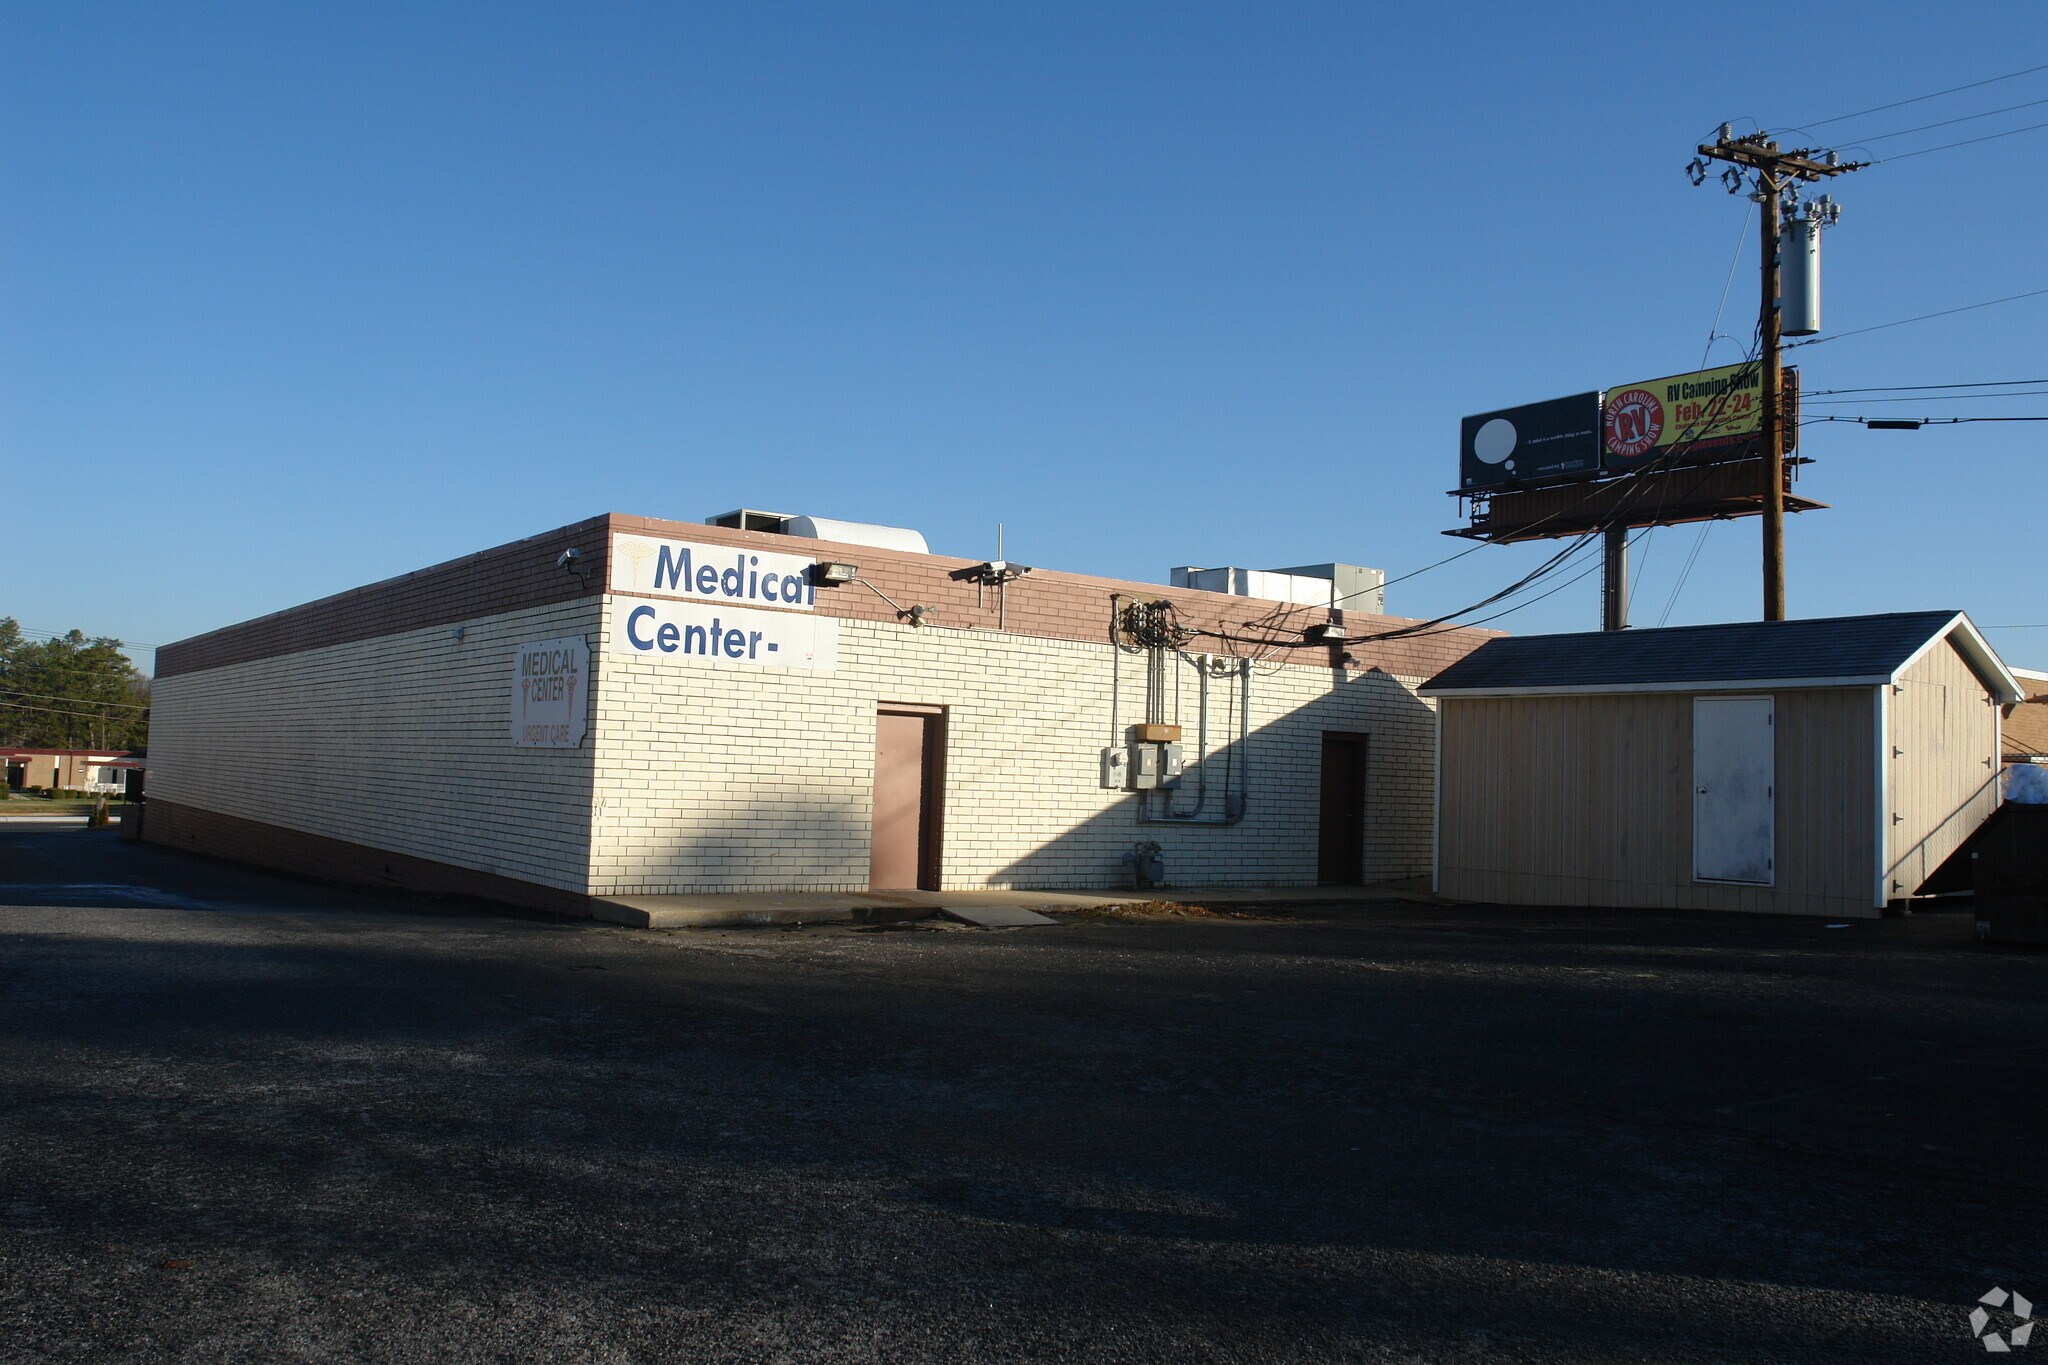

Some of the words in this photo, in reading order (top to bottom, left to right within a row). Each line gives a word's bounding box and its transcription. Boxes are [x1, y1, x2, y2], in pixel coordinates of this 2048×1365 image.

[1667, 384, 1680, 402] RV
[1682, 377, 1728, 400] Camping
[1606, 399, 1623, 427] NORTH
[1623, 392, 1659, 414] CAROLINA
[1618, 406, 1645, 442] RV
[1607, 436, 1641, 455] CAMPING
[1640, 423, 1660, 450] SHOW
[653, 545, 815, 605] Medical
[522, 648, 578, 677] MEDICAL
[531, 676, 564, 703] CENTER
[522, 724, 549, 743] URGENT
[550, 724, 570, 743] CARE
